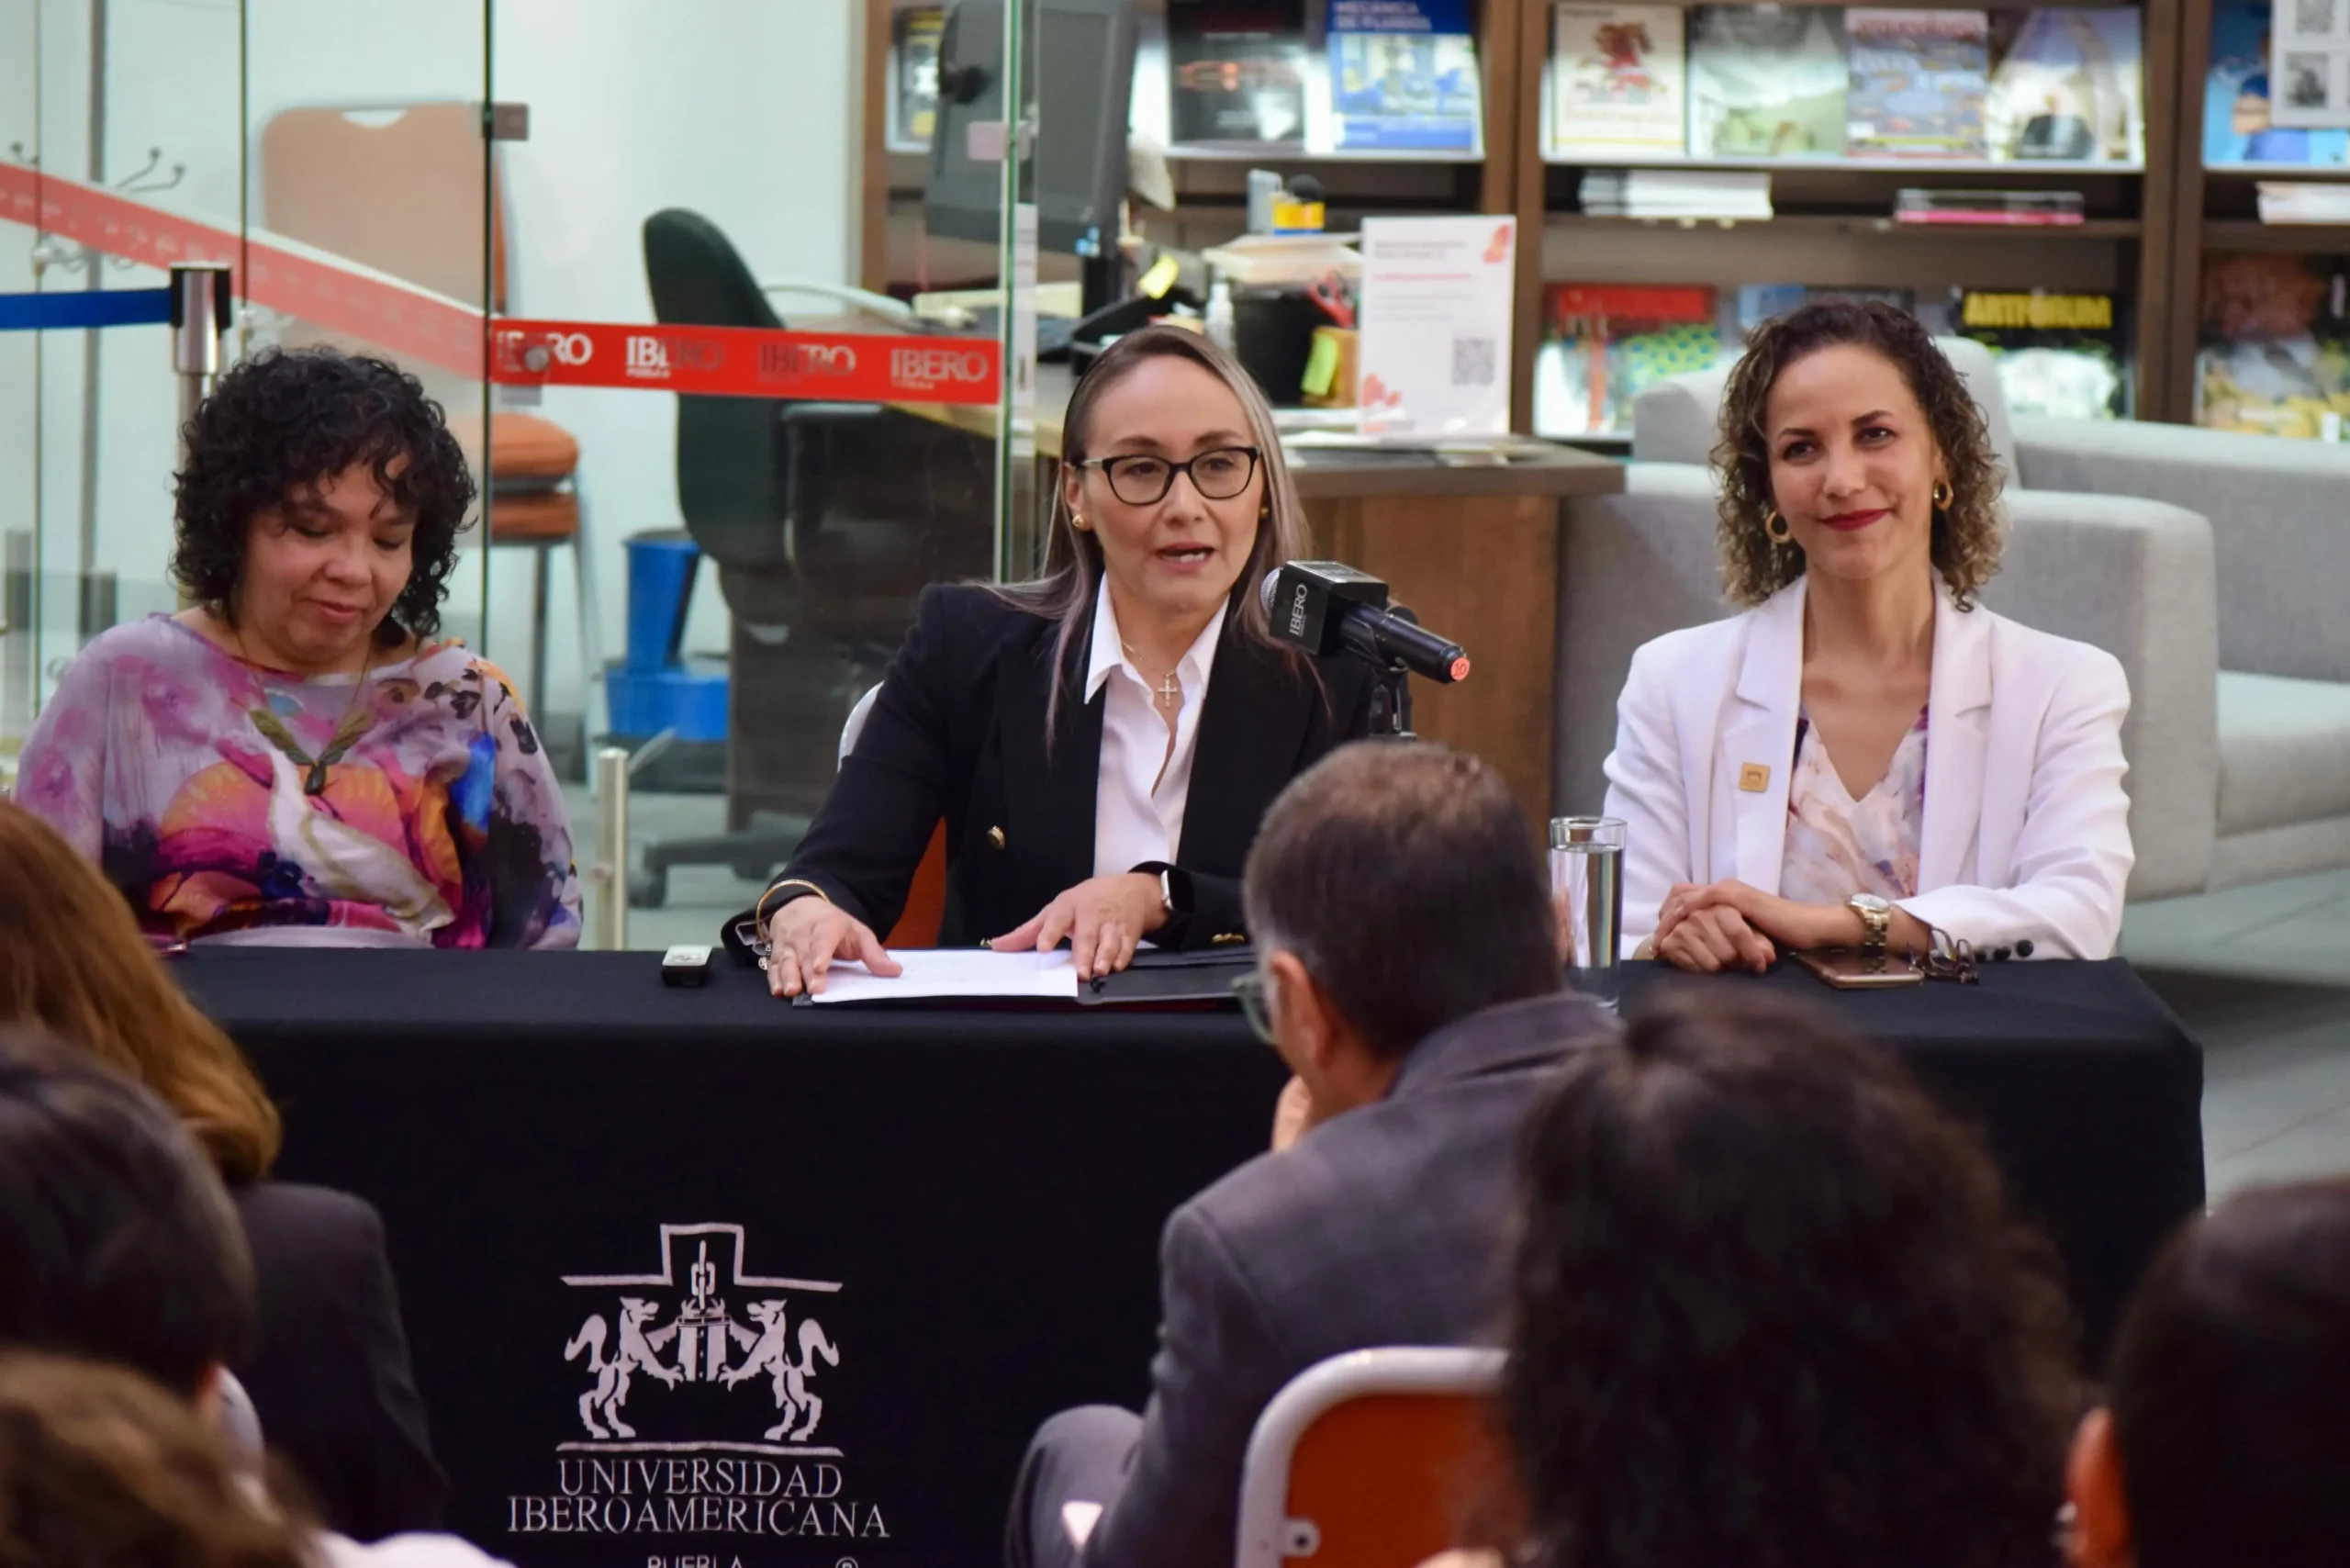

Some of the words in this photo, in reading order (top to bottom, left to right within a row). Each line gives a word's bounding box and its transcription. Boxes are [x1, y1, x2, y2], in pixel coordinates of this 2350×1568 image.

[1963, 292, 2112, 329] ARTFORUM
[890, 348, 989, 383] IBERO
[1289, 583, 1308, 635] IBERO
[1453, 663, 1467, 678] 10
[557, 1458, 843, 1498] UNIVERSIDAD
[508, 1495, 890, 1538] IBEROAMERICANA
